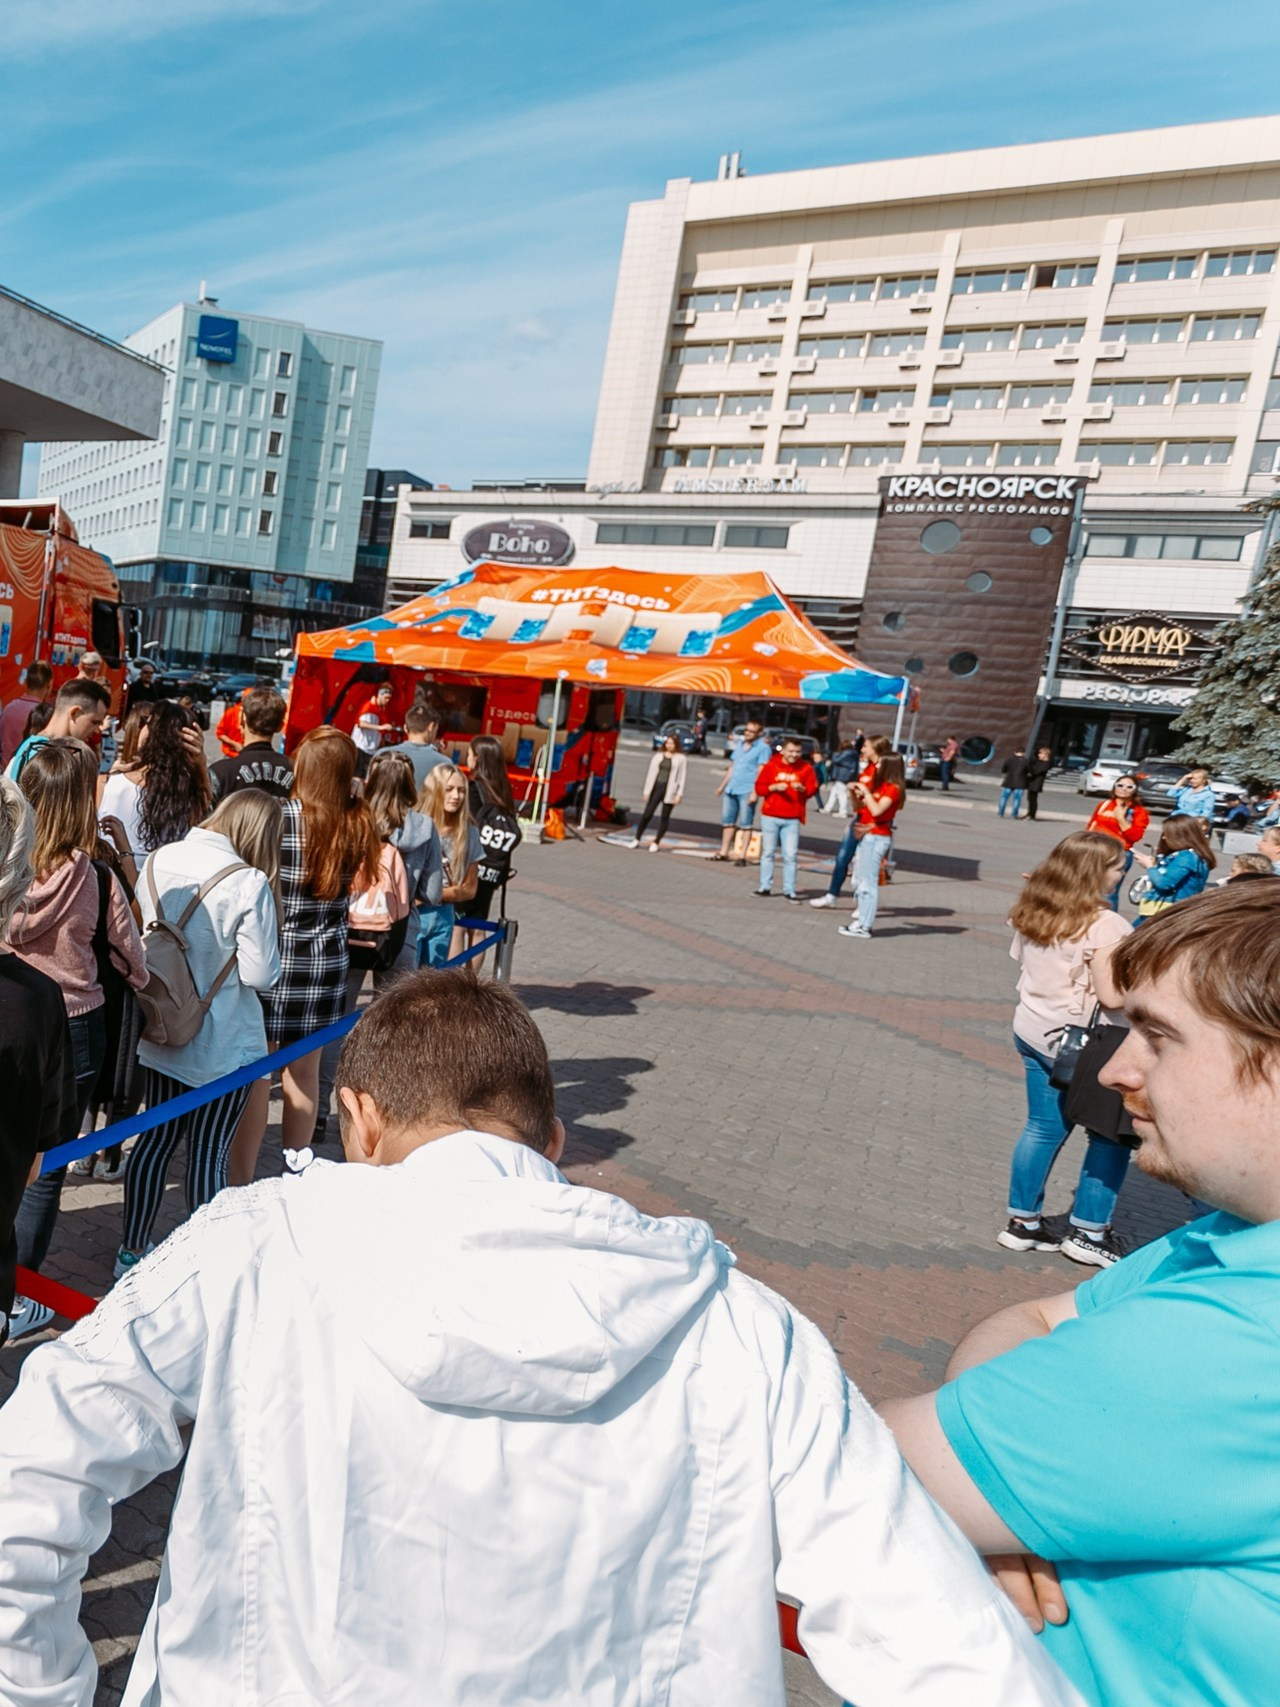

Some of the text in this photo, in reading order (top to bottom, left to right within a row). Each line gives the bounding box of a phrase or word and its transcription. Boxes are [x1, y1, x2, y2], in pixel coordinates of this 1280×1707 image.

[887, 475, 1077, 500] КРАСНОЯРСК
[886, 502, 1070, 516] КОМПЛЕКС РЕСТОРАНОВ
[530, 585, 671, 610] #ТНТздесь
[458, 596, 722, 656] ТНТ
[479, 824, 517, 852] 937
